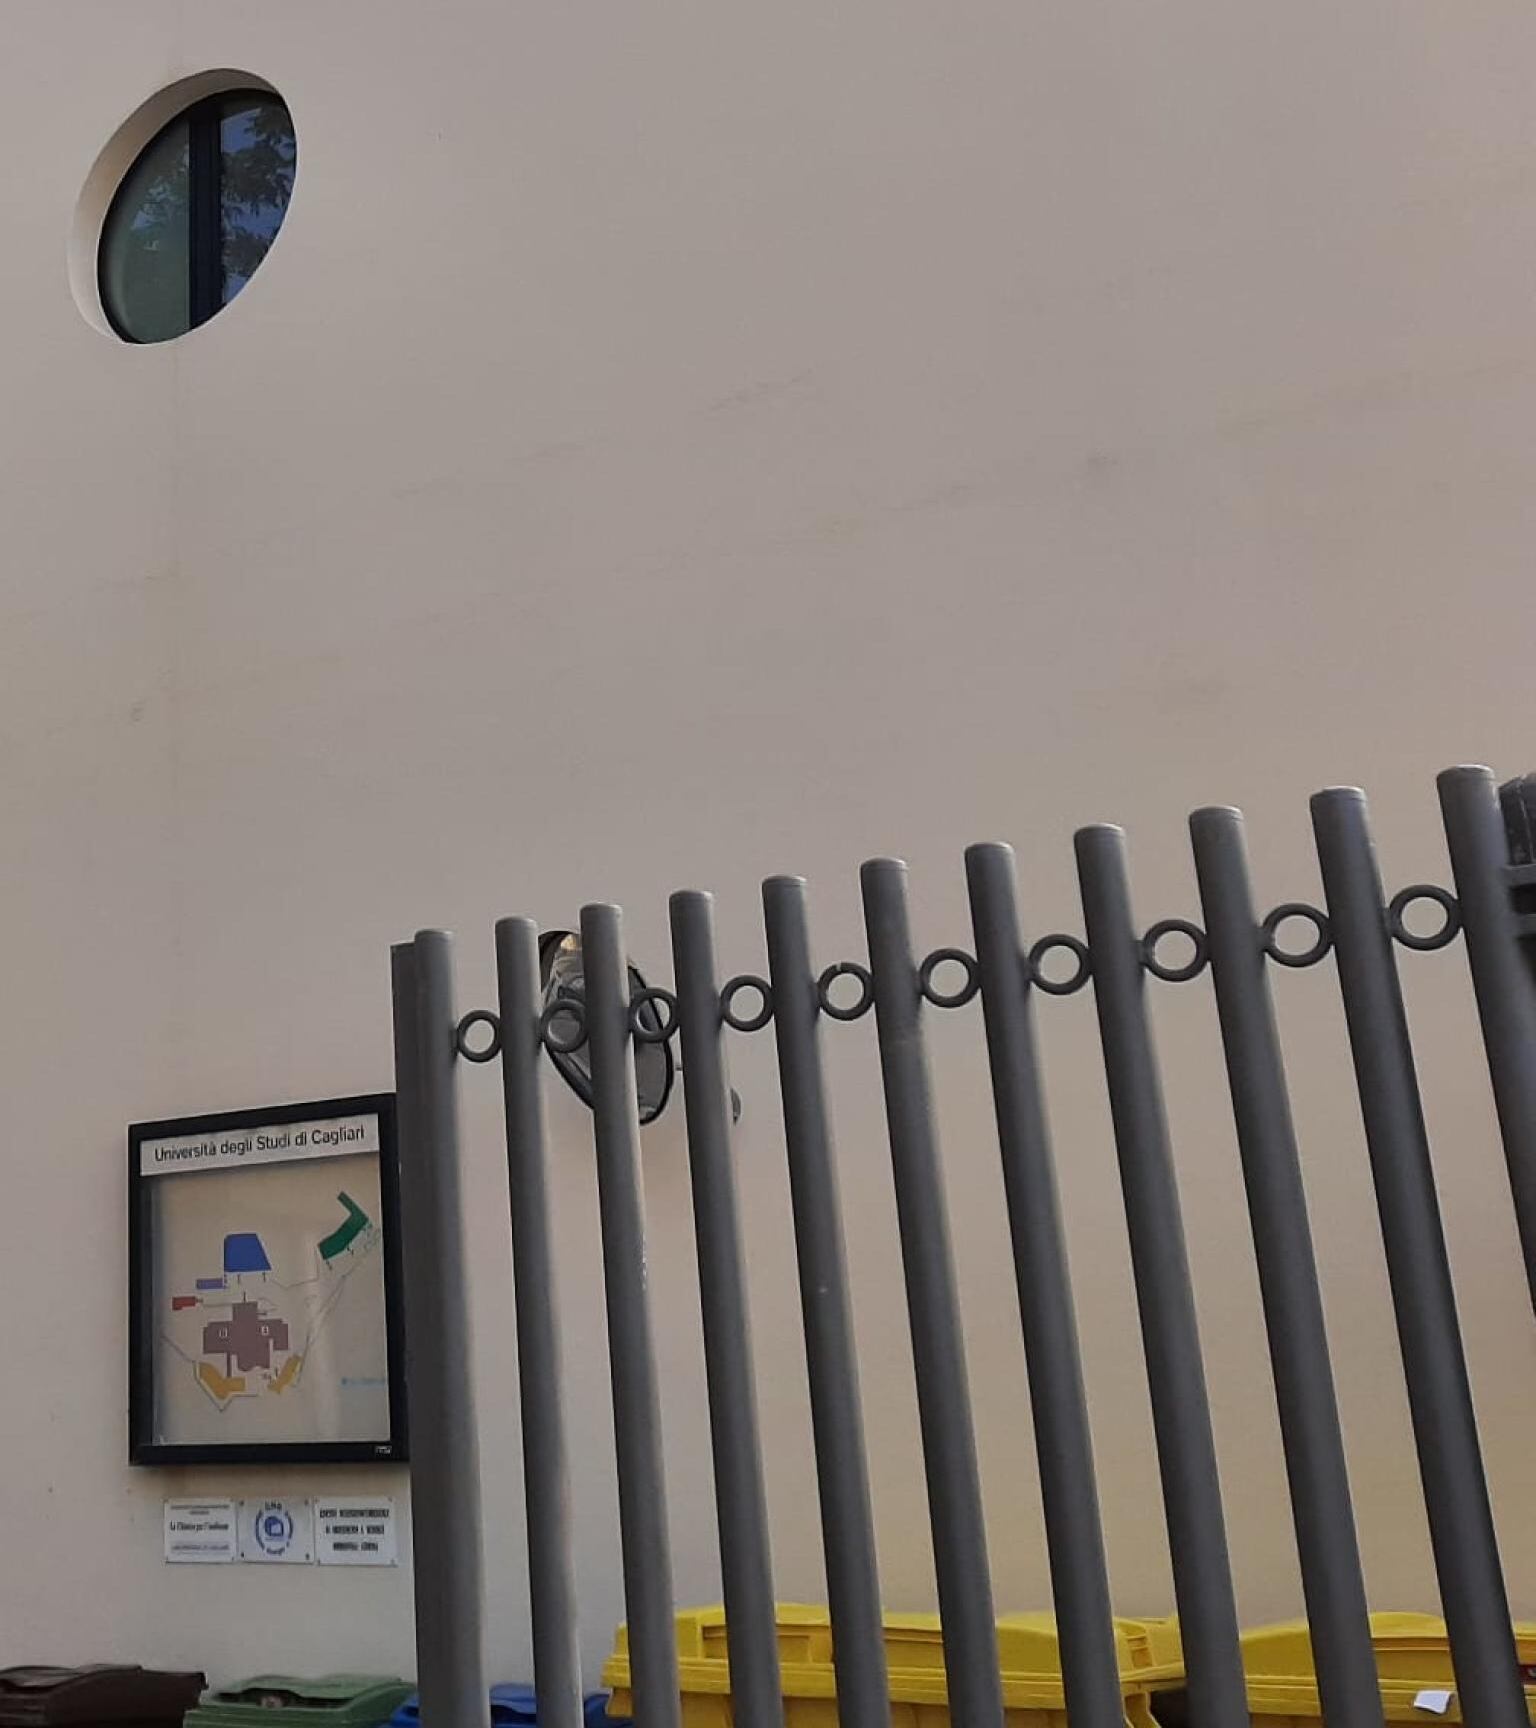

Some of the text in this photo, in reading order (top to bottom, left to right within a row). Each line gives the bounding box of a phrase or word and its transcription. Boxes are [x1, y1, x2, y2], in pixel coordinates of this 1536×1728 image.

[155, 1125, 364, 1161] Università degli Studi di Cagliari
